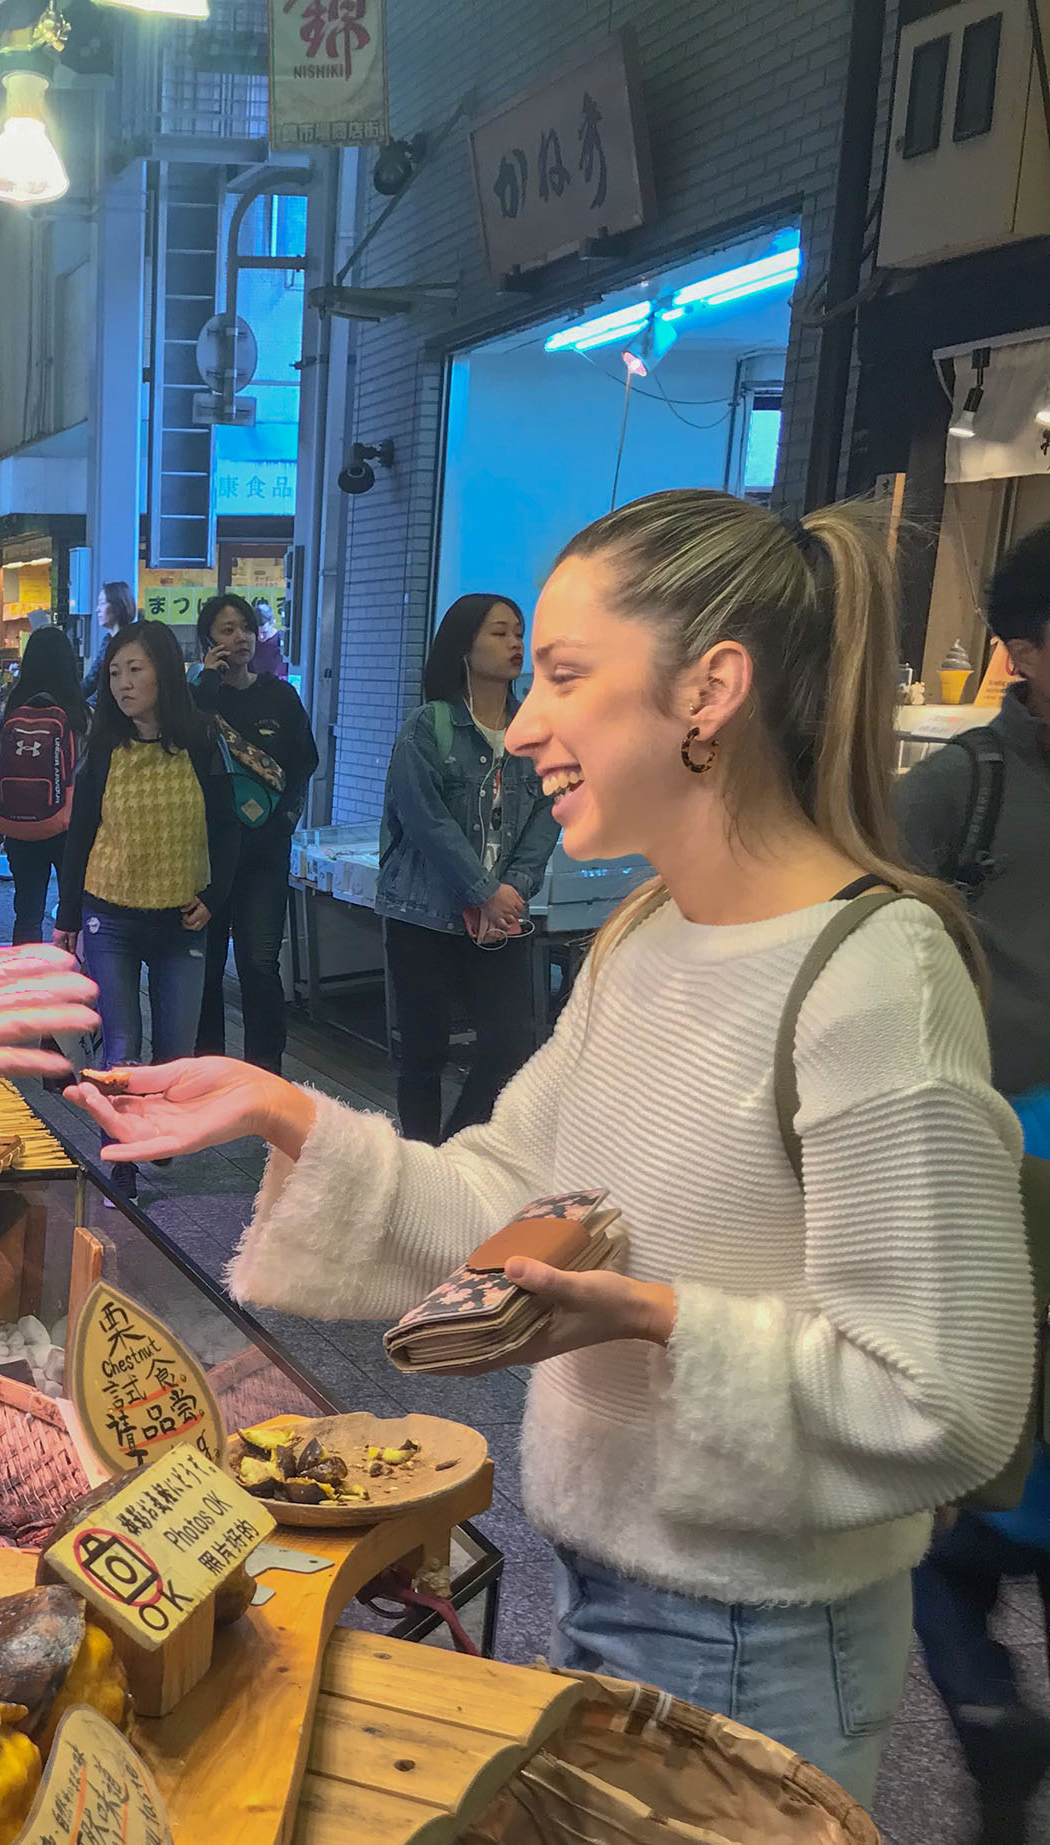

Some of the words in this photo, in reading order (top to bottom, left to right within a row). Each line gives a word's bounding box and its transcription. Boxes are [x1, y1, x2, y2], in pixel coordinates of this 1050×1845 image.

[293, 64, 344, 79] NISHIKI
[219, 475, 292, 499] 康食品
[99, 1302, 146, 1358] 栗
[101, 1336, 162, 1378] Chestnut
[163, 1510, 215, 1553] Photos
[202, 1489, 233, 1516] OK
[138, 1578, 195, 1631] OK
